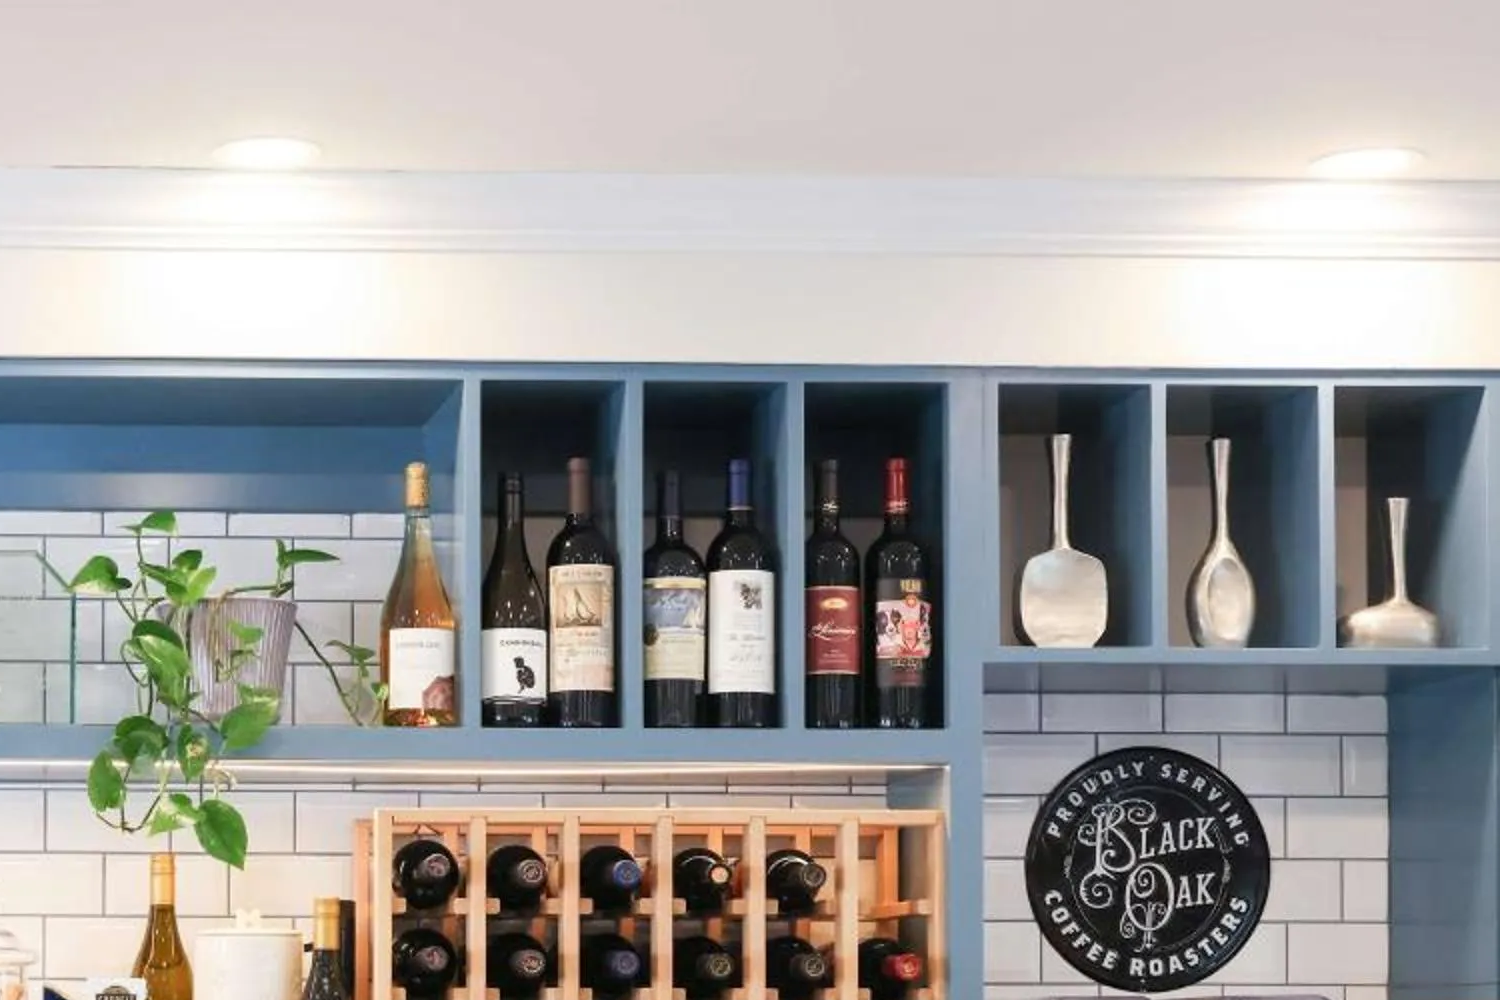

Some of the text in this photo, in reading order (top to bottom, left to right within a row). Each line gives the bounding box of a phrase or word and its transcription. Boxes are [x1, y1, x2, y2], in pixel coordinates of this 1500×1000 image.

[1047, 761, 1250, 847] PROUDLY SERVING
[1077, 798, 1216, 909] BLACK
[1044, 890, 1249, 977] COFFEE ROASTERS
[1120, 863, 1216, 952] OAK
